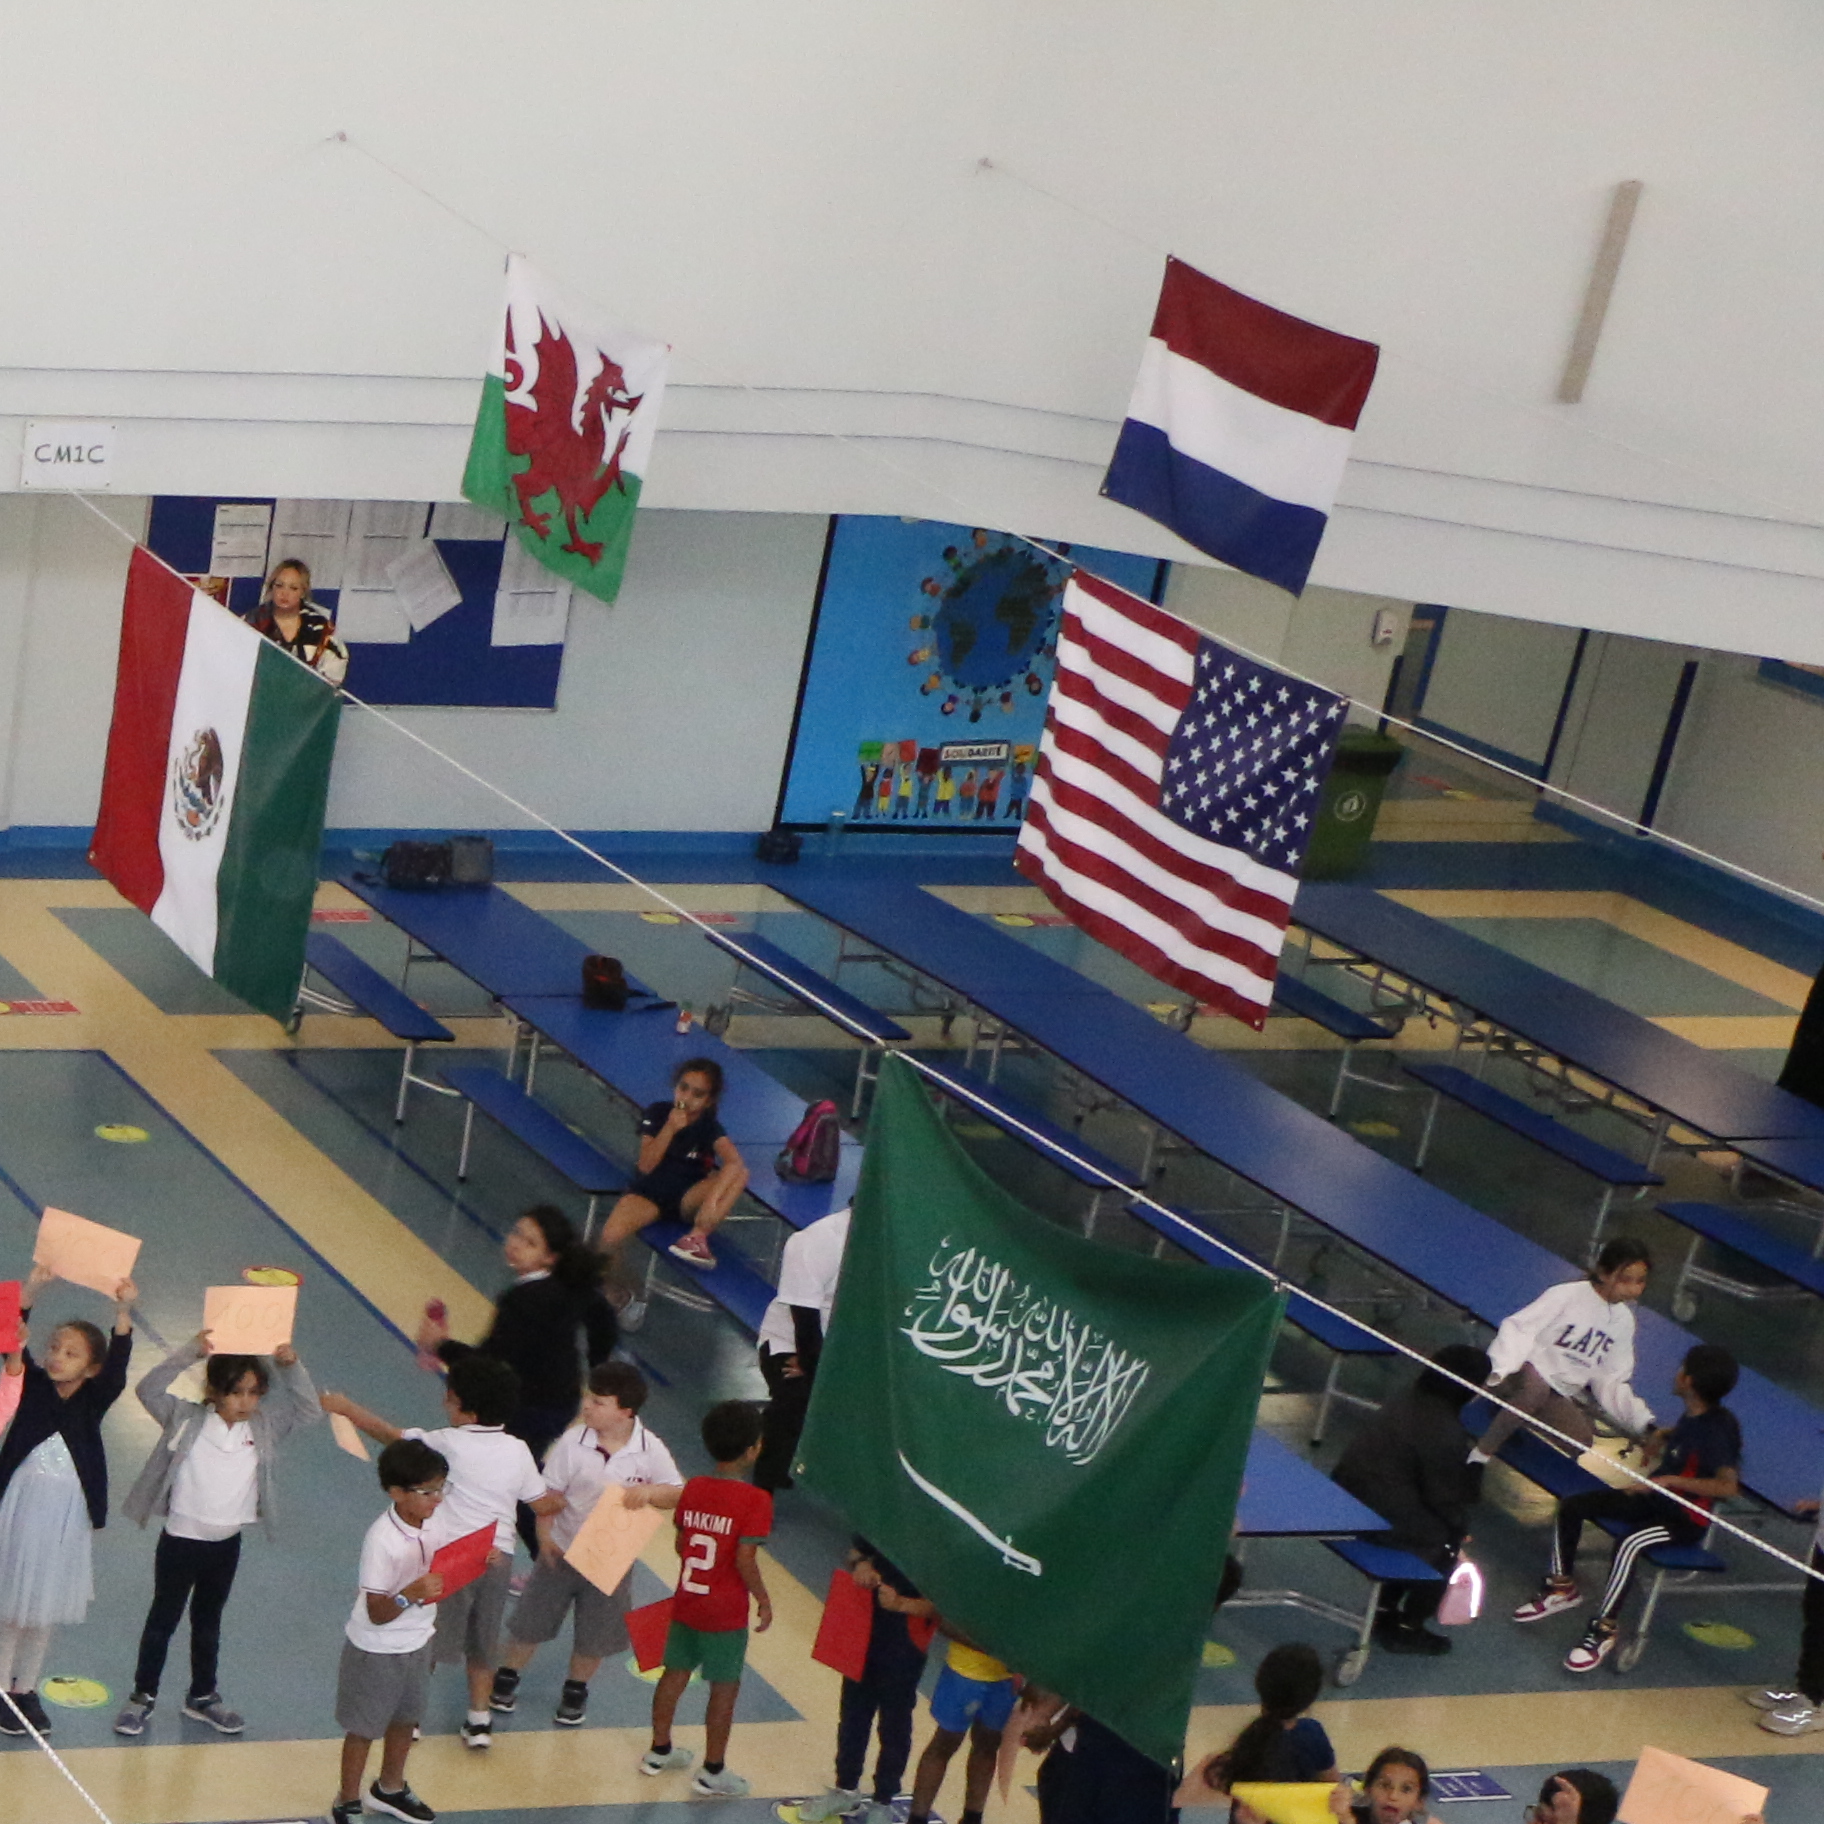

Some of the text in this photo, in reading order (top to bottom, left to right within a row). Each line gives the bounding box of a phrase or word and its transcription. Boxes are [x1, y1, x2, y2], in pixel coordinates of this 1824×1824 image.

[34, 443, 105, 464] CM1C
[215, 1301, 284, 1331] 100
[683, 1510, 734, 1535] HAKIMI
[682, 1533, 717, 1595] 2
